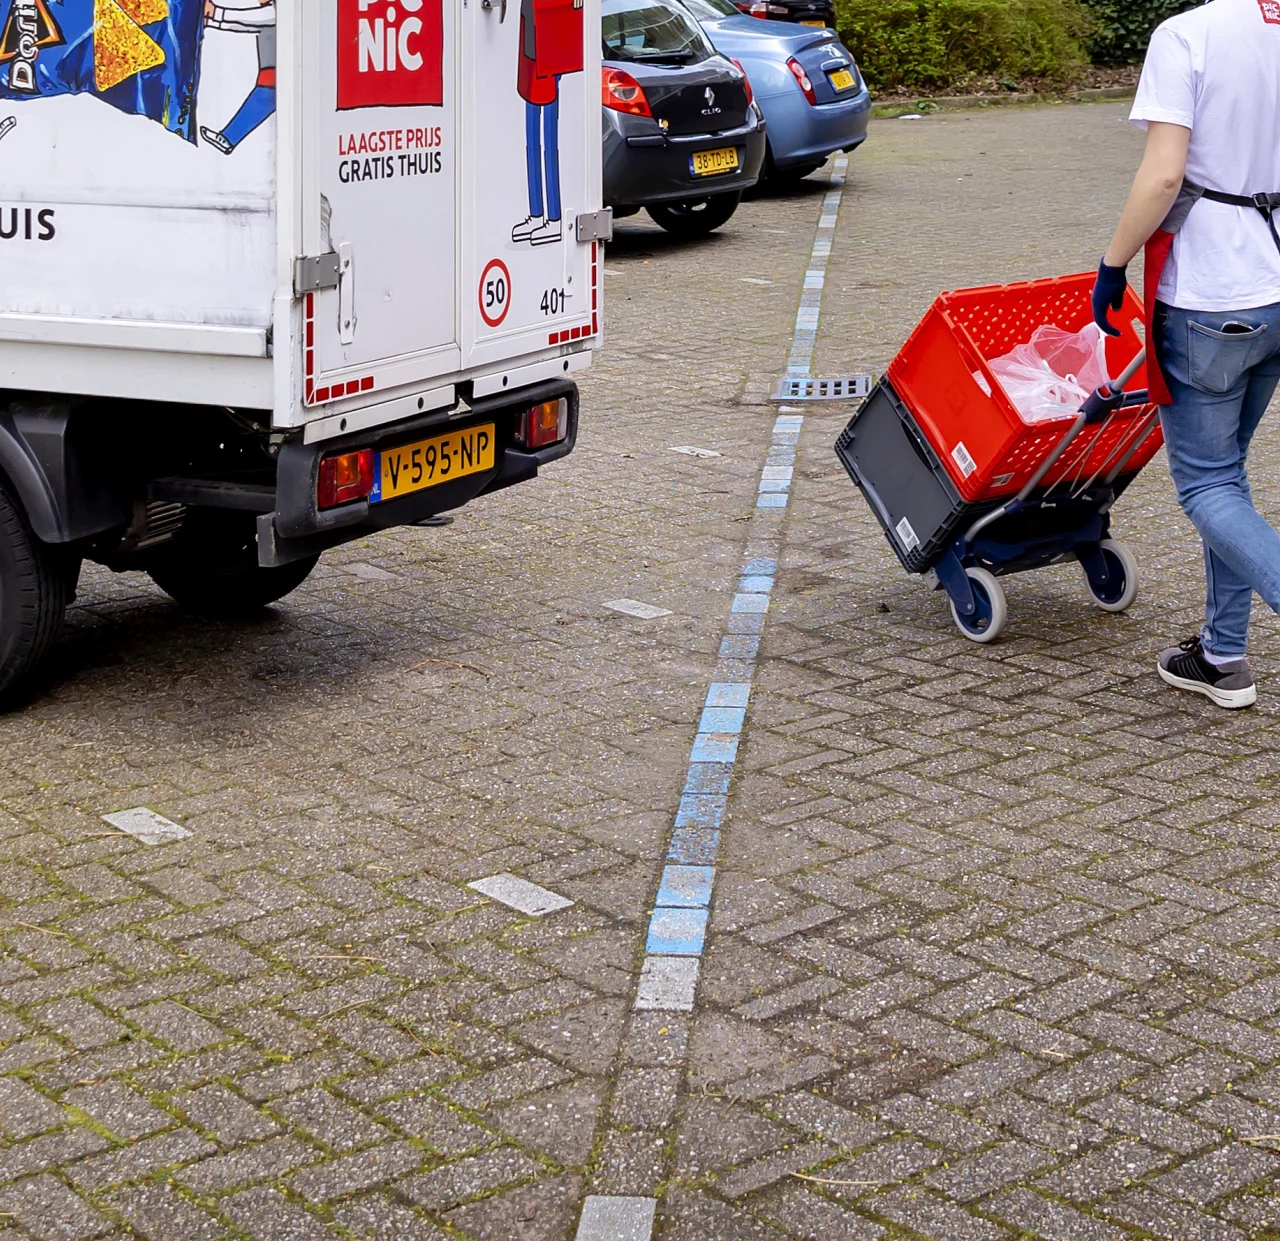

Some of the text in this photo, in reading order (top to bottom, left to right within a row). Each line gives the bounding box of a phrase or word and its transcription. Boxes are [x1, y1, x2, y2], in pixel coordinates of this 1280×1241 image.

[701, 107, 721, 116] CLIO
[338, 127, 442, 156] LAAGSTE PRIJS
[338, 151, 442, 184] GRATIS THUIS
[697, 150, 735, 170] 38-TD-LB
[486, 278, 505, 308] 50
[540, 288, 565, 316] 401
[388, 431, 489, 490] V-595-NP
